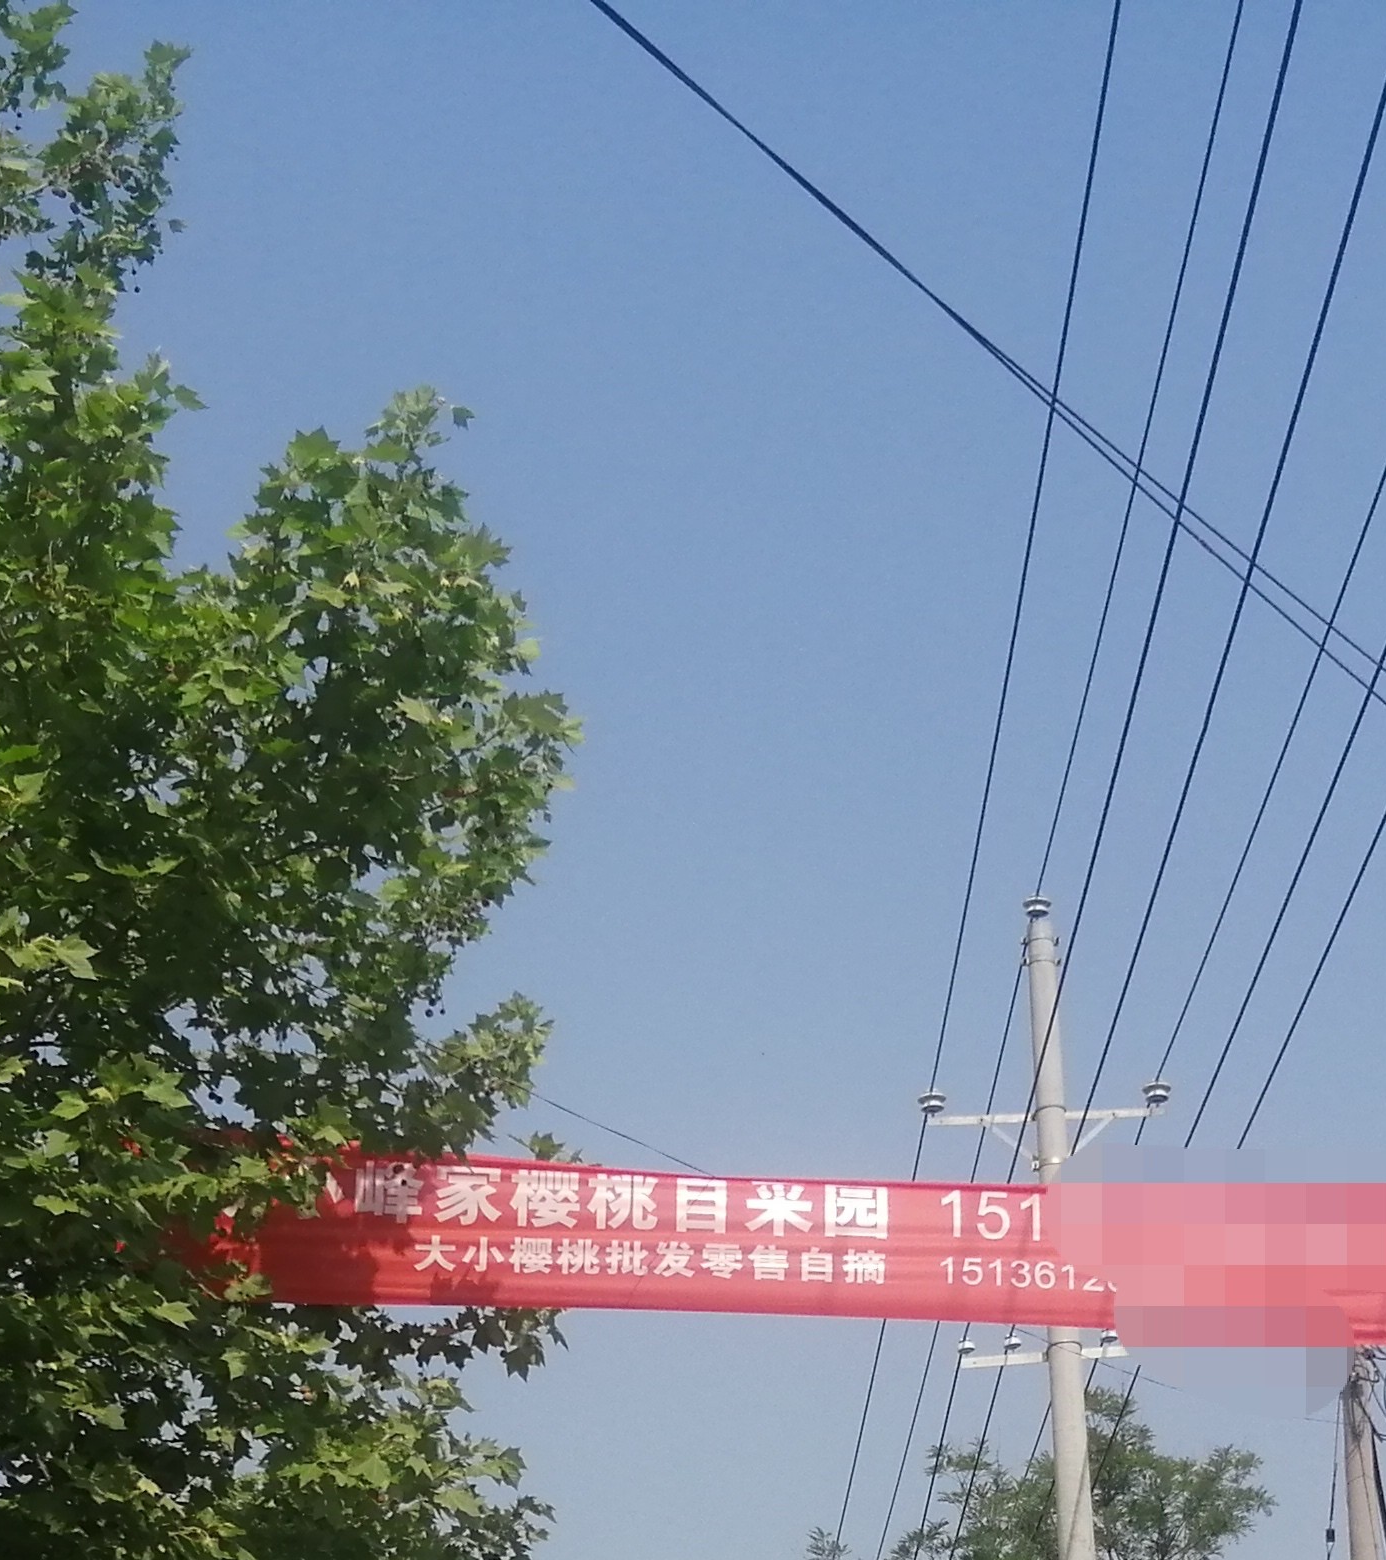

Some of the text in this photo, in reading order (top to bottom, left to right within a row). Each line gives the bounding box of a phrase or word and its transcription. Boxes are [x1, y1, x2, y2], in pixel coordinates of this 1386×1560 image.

[413, 1235, 886, 1285] 大小樱桃批发零售自摘
